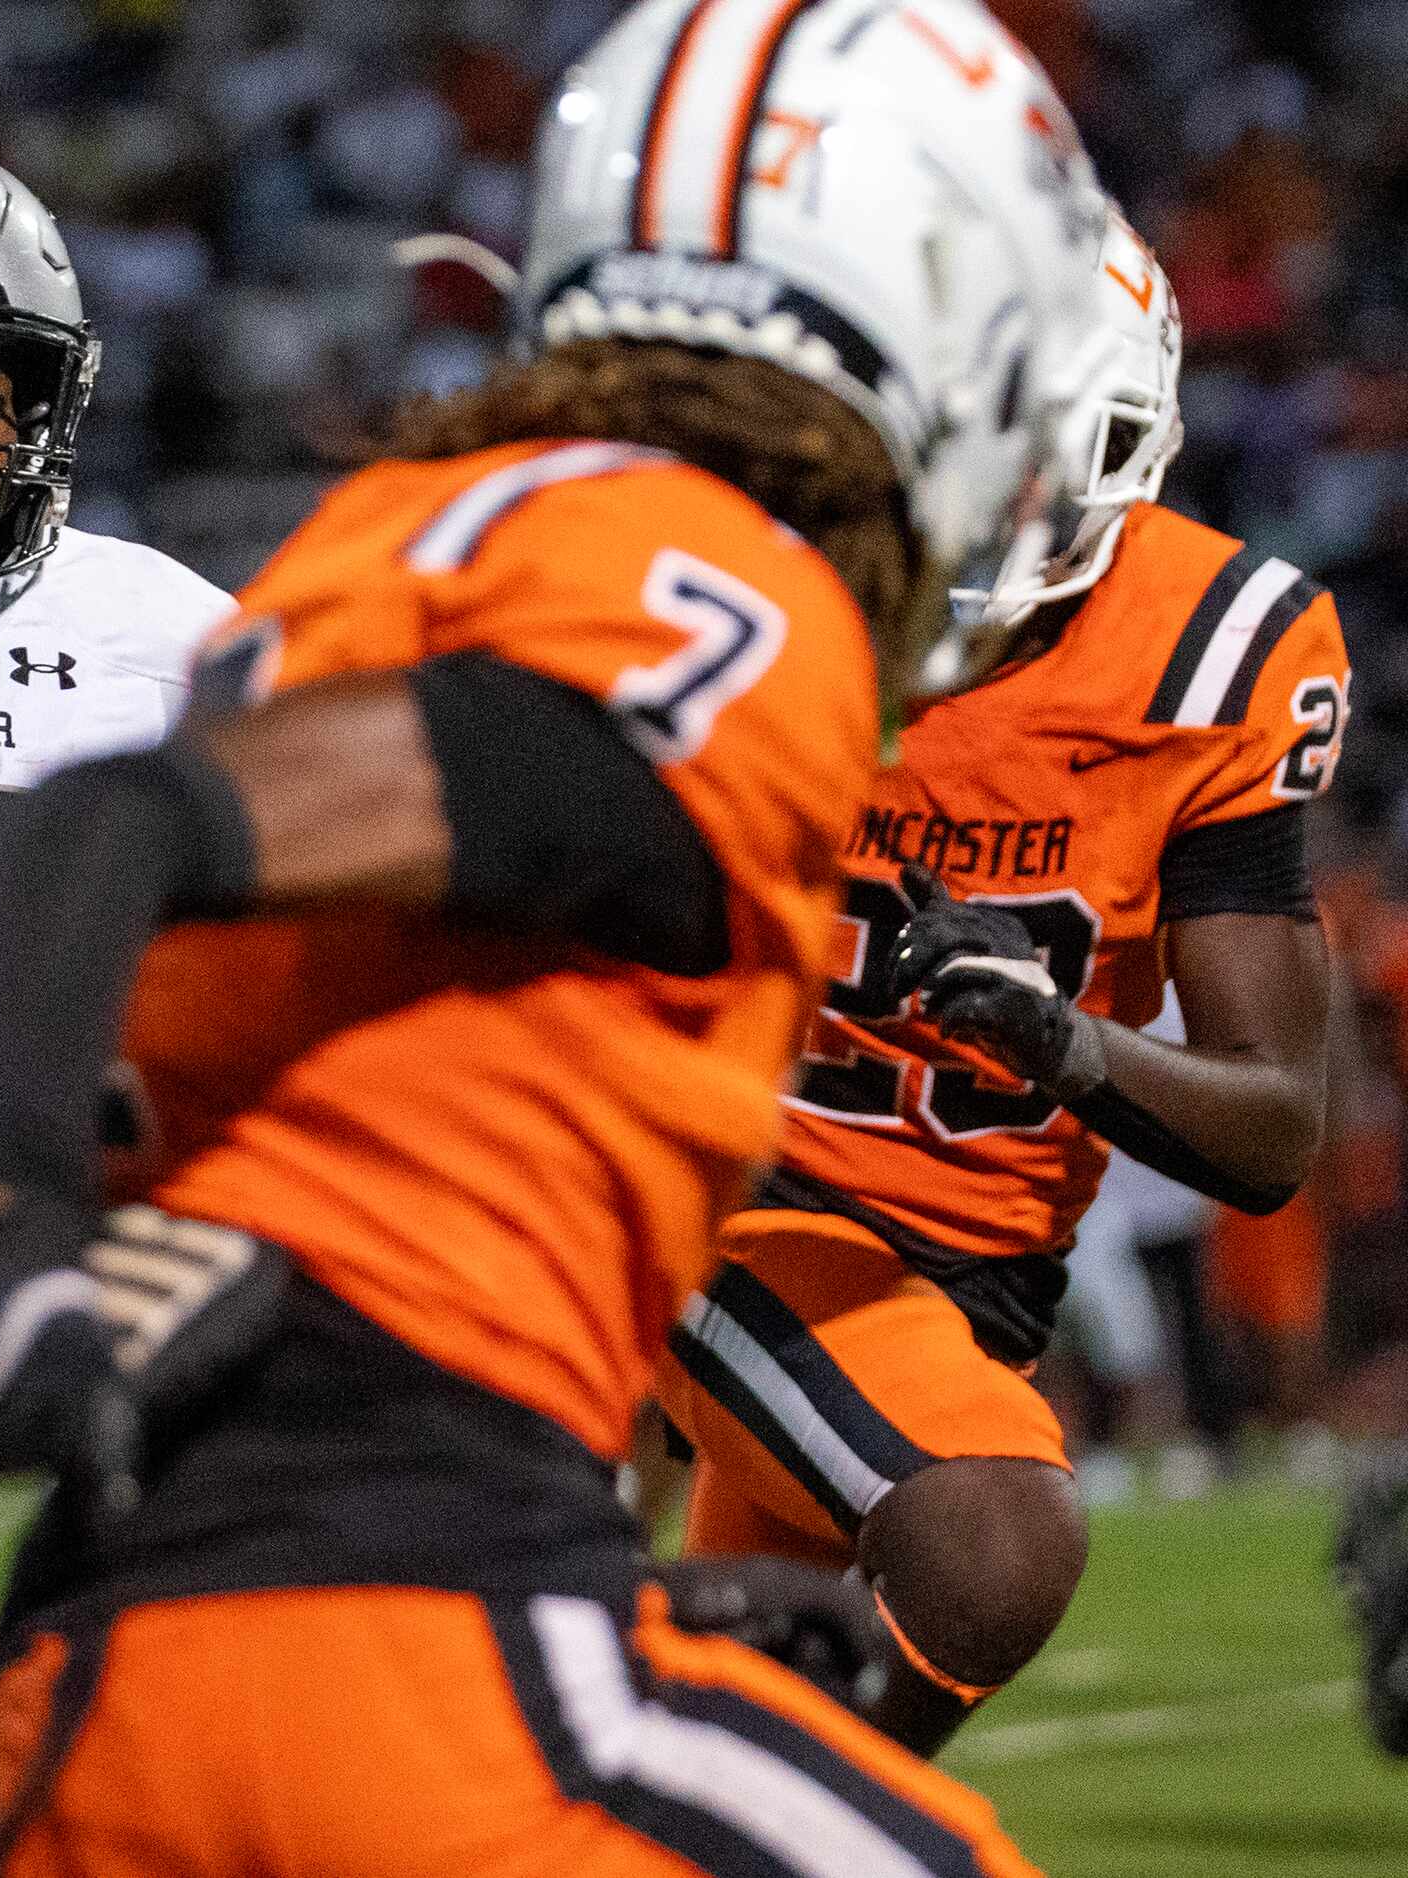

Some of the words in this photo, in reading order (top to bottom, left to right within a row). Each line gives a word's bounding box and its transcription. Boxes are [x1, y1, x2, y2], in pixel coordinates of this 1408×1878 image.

[609, 547, 789, 767] 7
[1270, 667, 1353, 800] 2
[845, 806, 1073, 878] NCASTER
